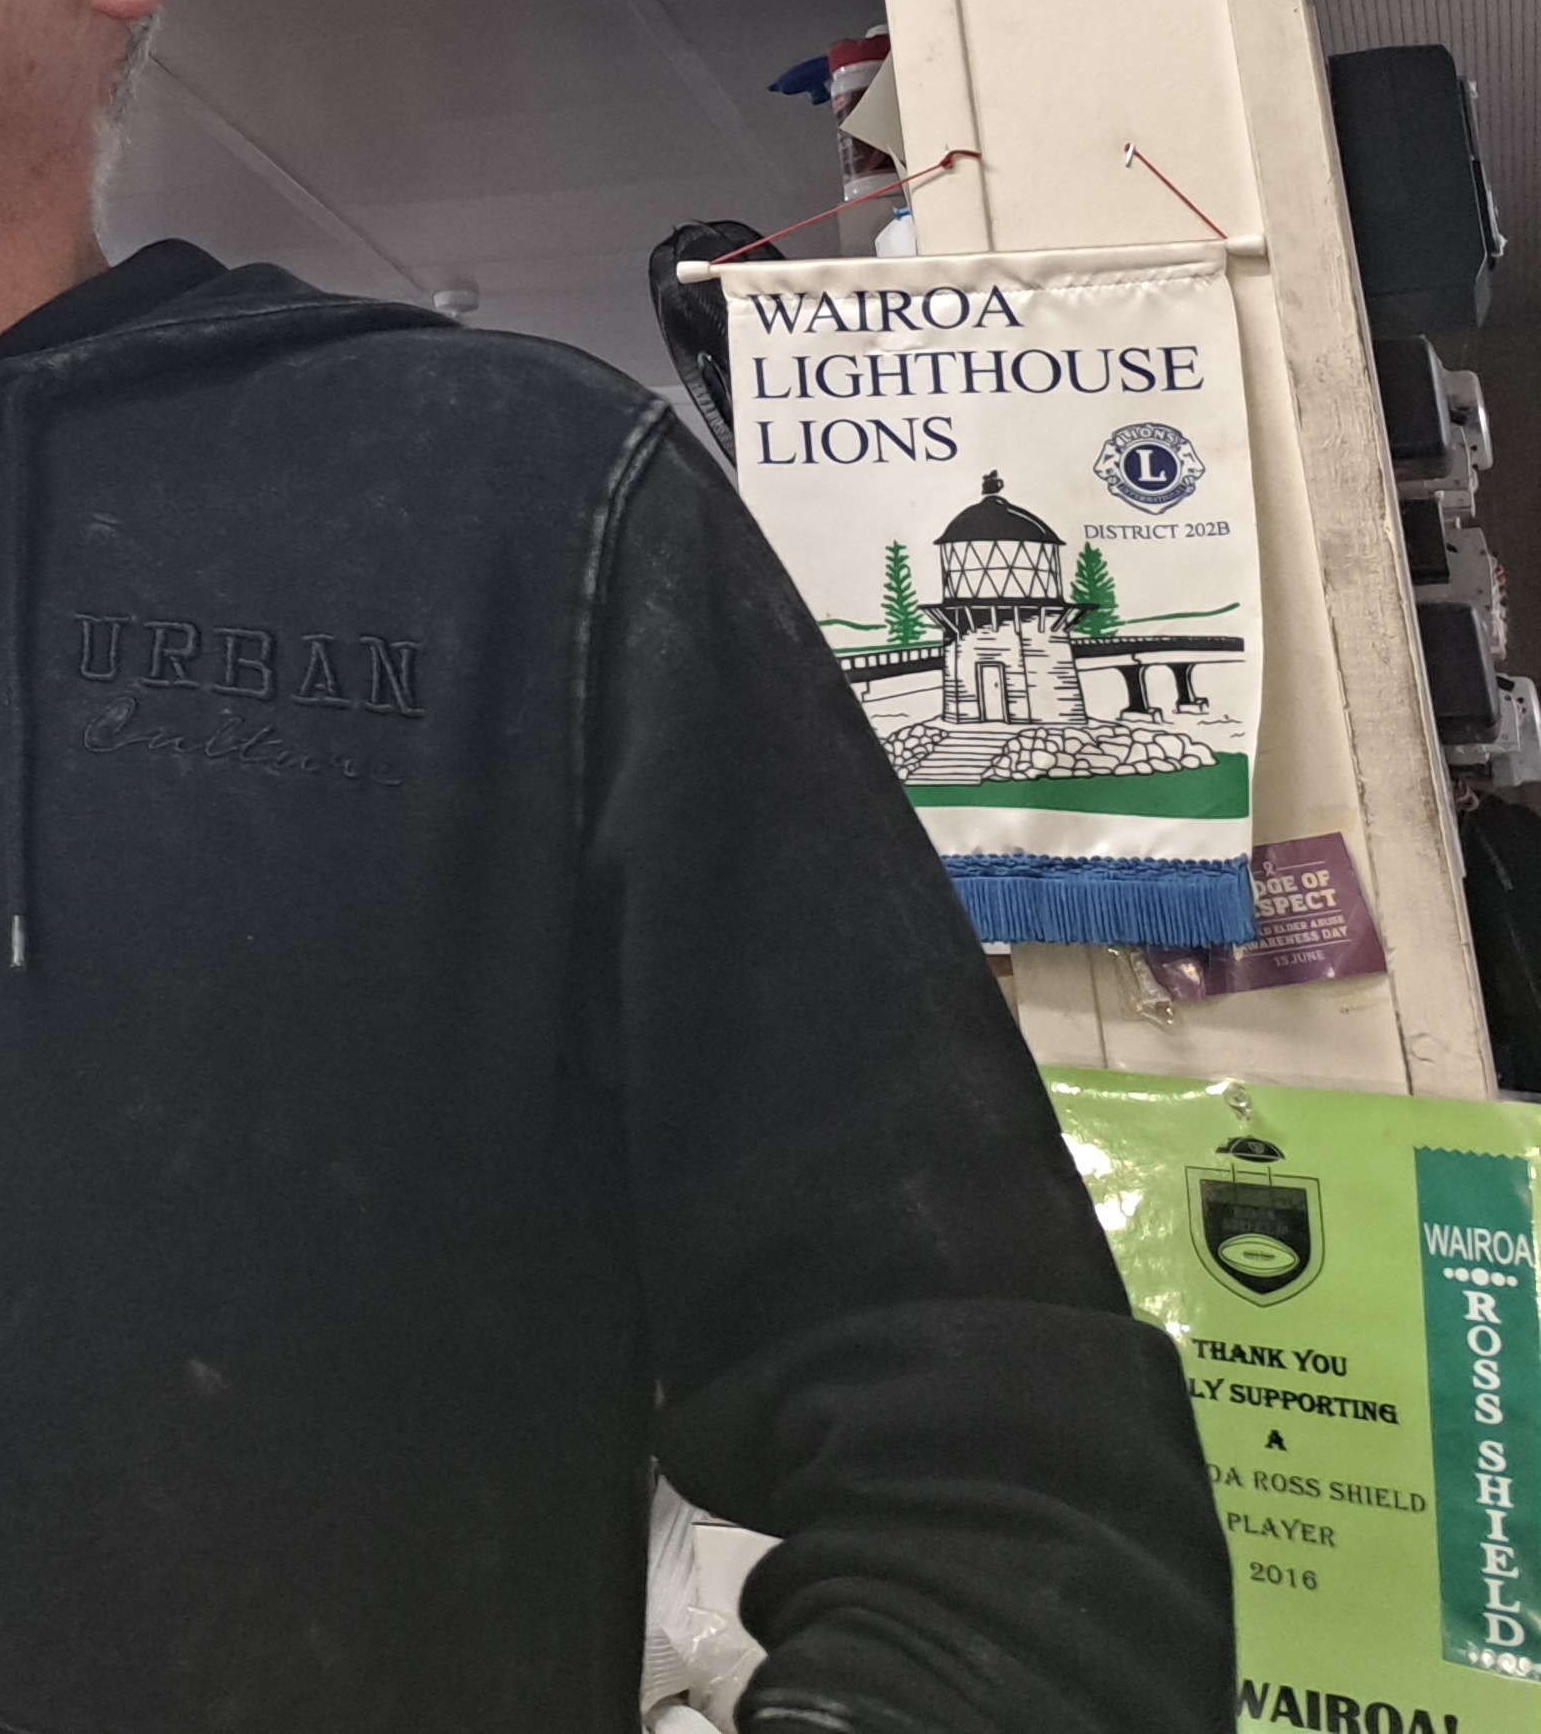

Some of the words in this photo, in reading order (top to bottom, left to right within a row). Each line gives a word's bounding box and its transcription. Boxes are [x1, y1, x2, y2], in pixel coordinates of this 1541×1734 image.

[747, 284, 1026, 335] WAIROA
[751, 345, 1206, 400] LIGHTHOUSE
[755, 416, 959, 466] LIONS
[1116, 426, 1177, 446] LIONS
[1135, 449, 1168, 482] L
[1083, 524, 1179, 540] DISTRICT
[1184, 520, 1231, 538] 202B
[74, 614, 426, 721] URBAN
[83, 696, 405, 787] Culture
[1301, 869, 1330, 890] OF
[1273, 921, 1308, 935] ELDER
[1310, 915, 1346, 929] ABUSE
[1321, 925, 1349, 940] DAY
[1291, 949, 1326, 965] JUNE
[1424, 1222, 1537, 1267] WAIROA
[1191, 1338, 1287, 1370] THANK
[1293, 1349, 1350, 1378] YOU
[1462, 1289, 1505, 1426] ROSS
[1229, 1383, 1401, 1426] SUPPORTING
[1265, 1428, 1288, 1452] A
[1253, 1469, 1322, 1499] ROSS
[1328, 1480, 1428, 1515] SHIELD
[1226, 1511, 1338, 1549] PLAYER
[1474, 1439, 1526, 1648] SHIELD
[1248, 1560, 1320, 1591] 2016
